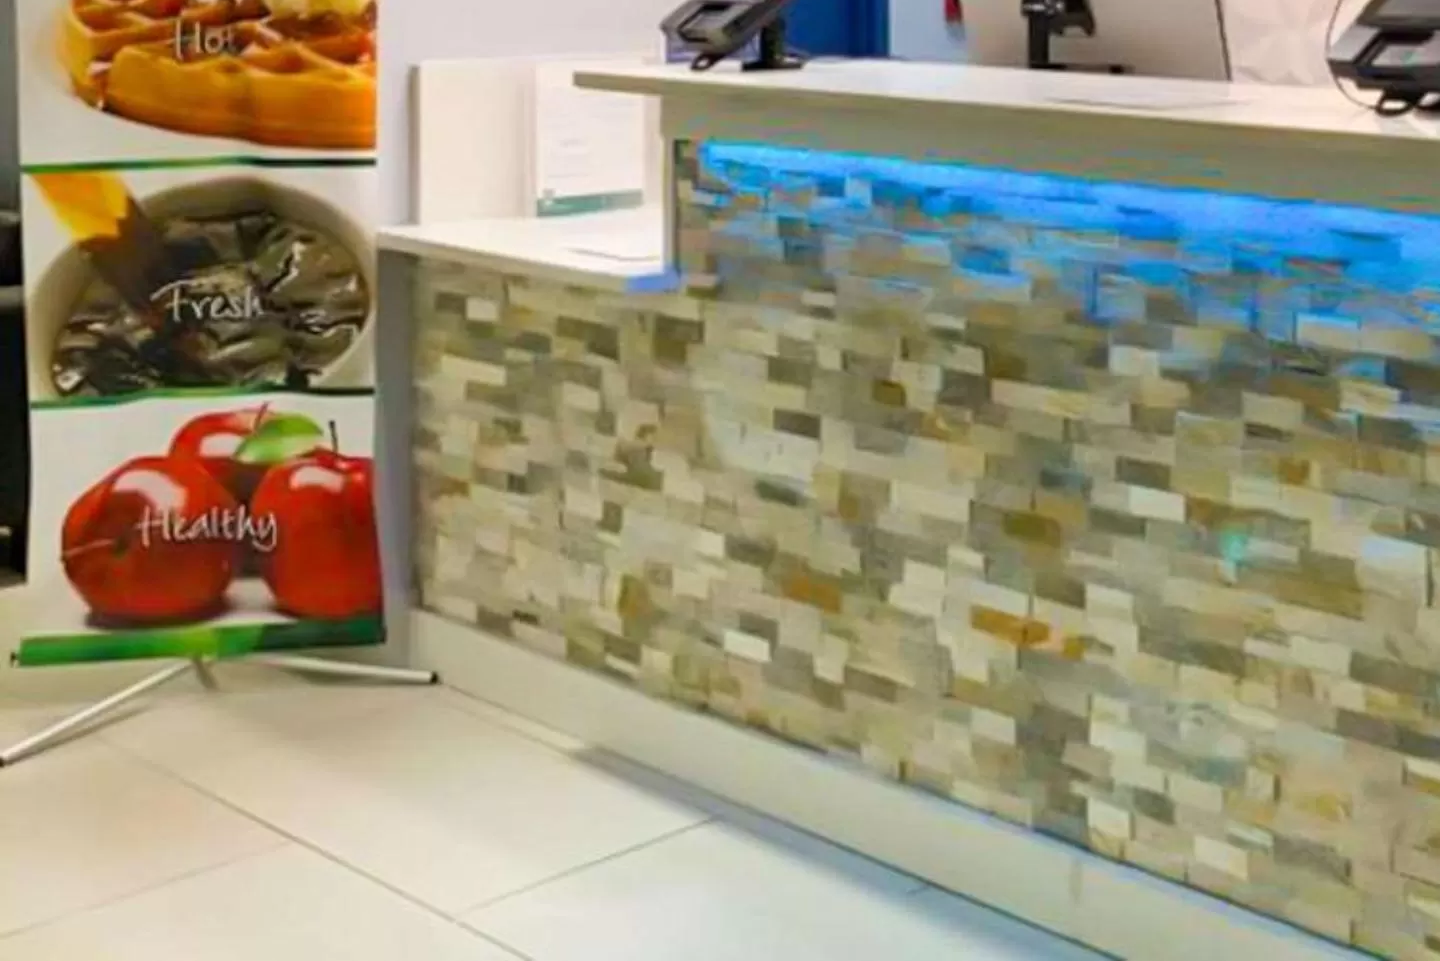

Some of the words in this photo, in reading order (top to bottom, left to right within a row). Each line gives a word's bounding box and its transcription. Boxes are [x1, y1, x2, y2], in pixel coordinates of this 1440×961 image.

[174, 18, 236, 61] Hot
[150, 278, 265, 323] Fresh
[137, 504, 278, 551] Healthy
